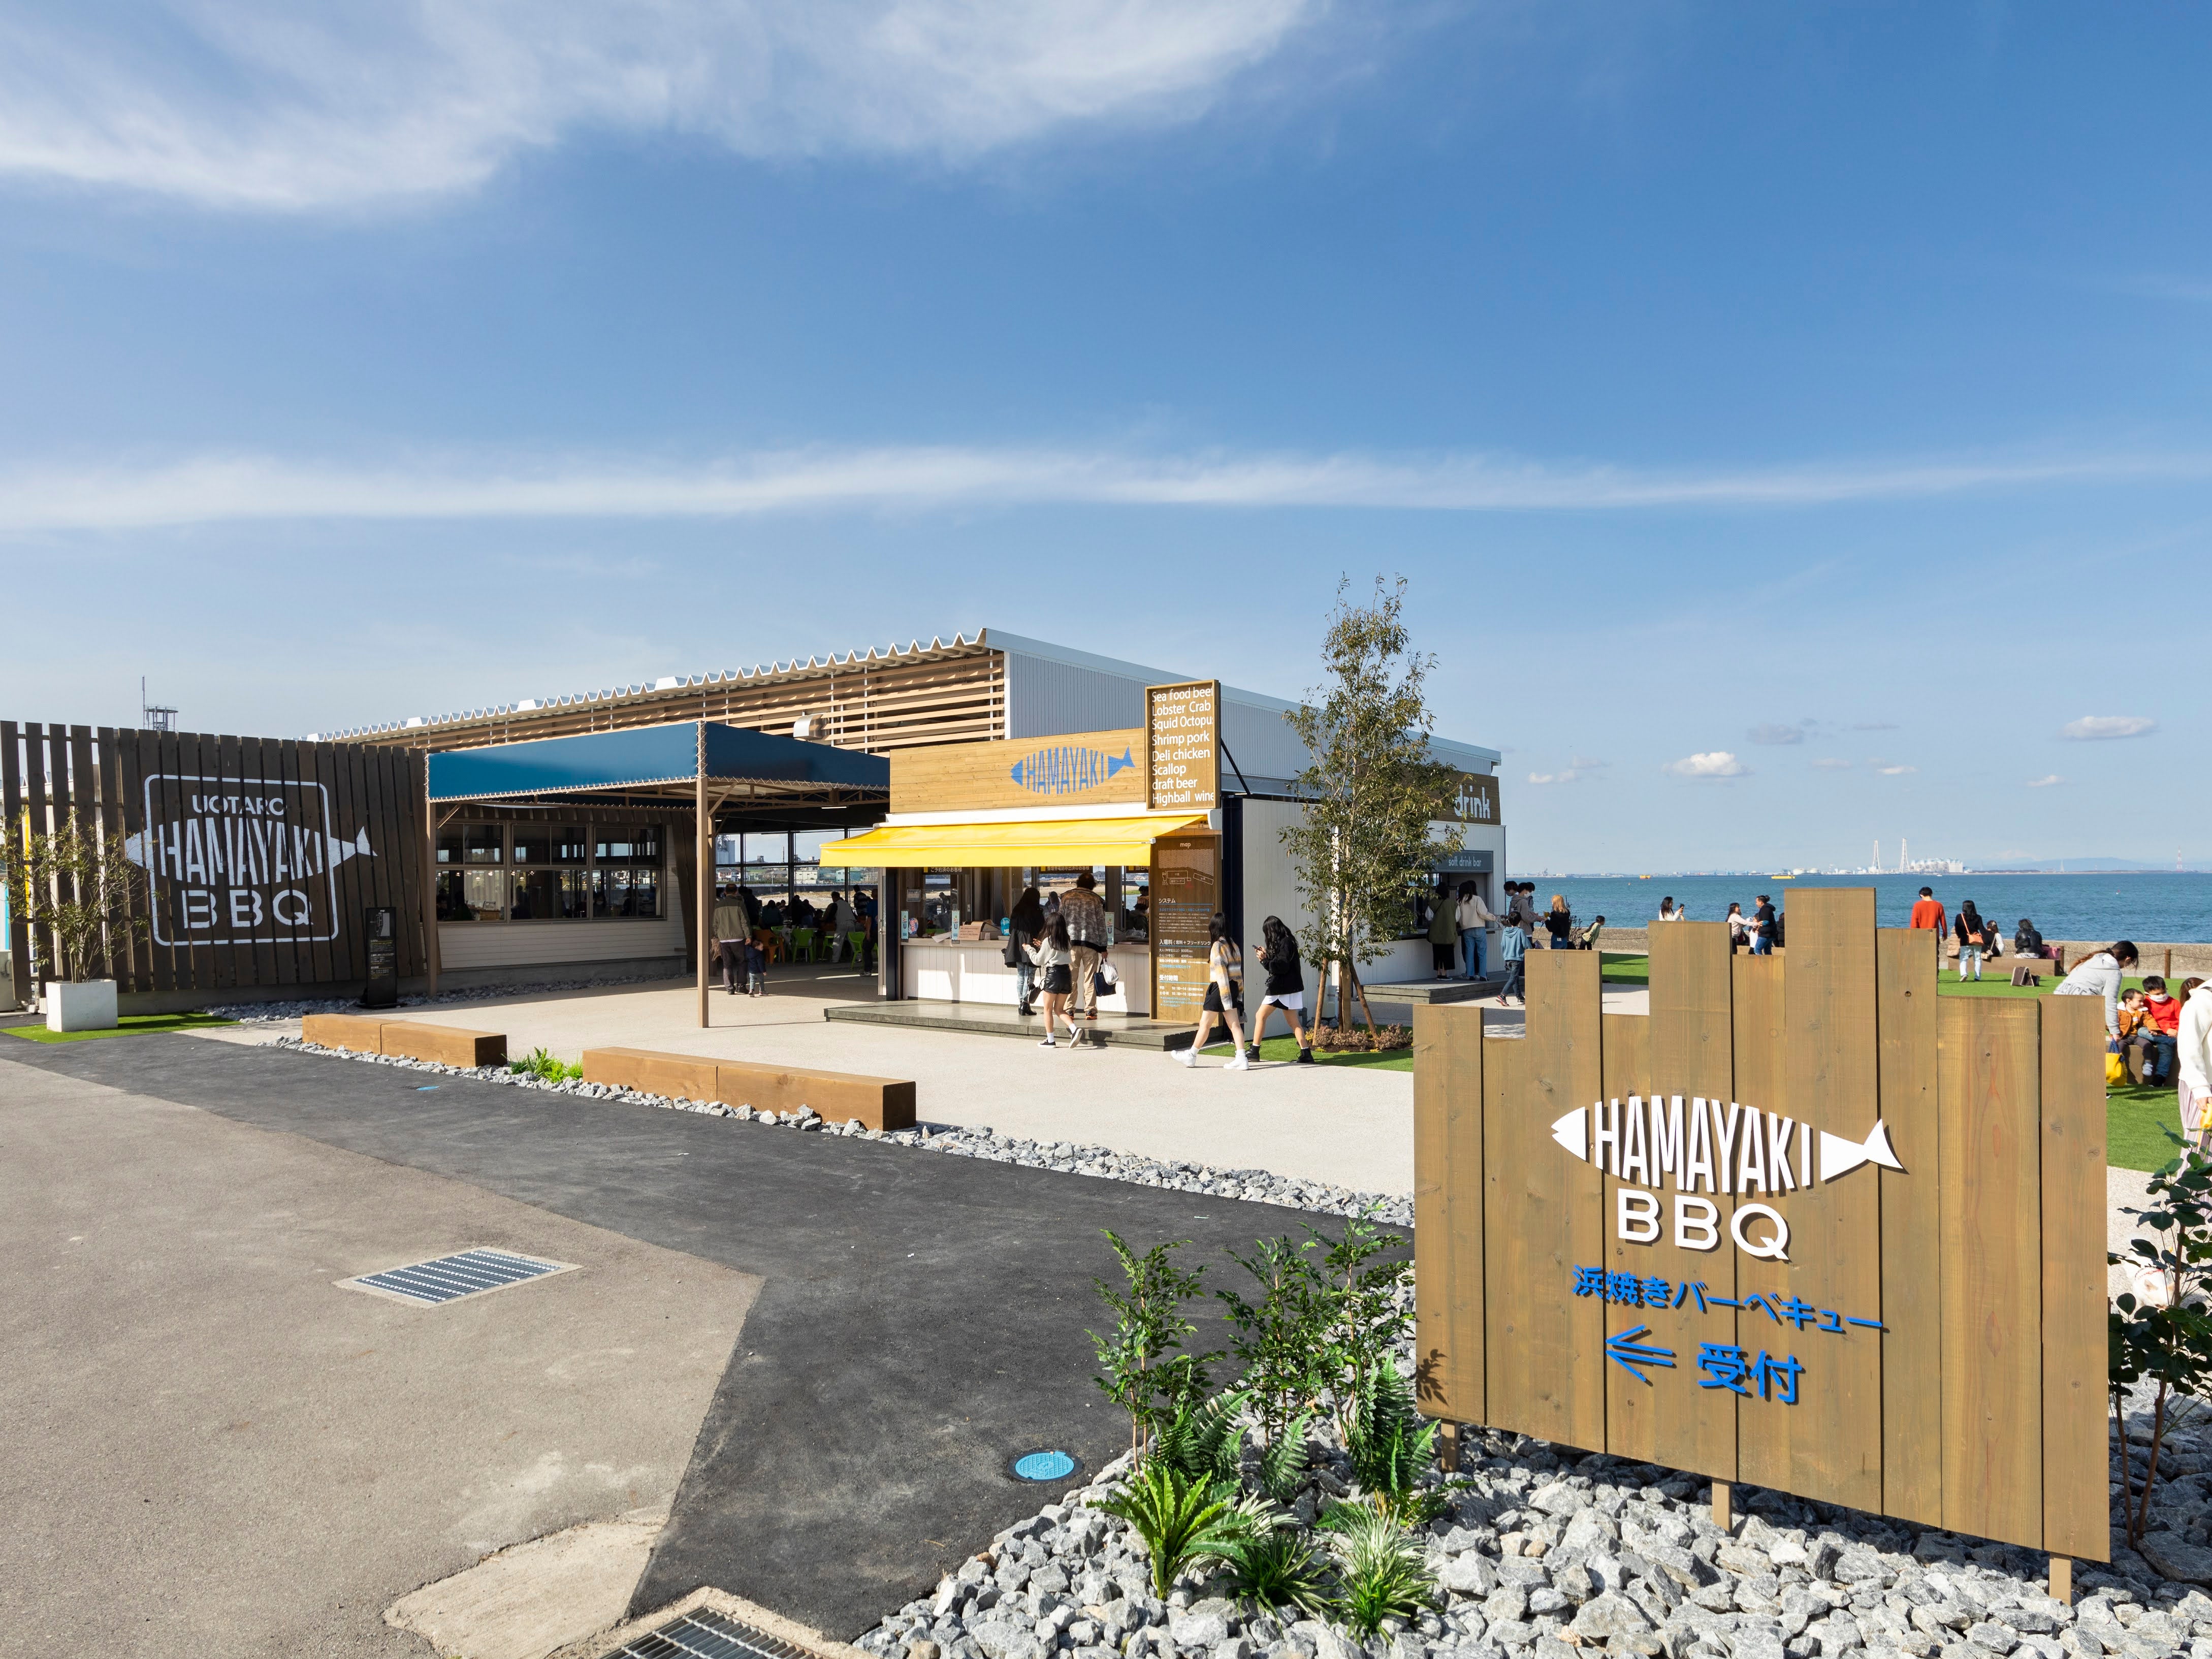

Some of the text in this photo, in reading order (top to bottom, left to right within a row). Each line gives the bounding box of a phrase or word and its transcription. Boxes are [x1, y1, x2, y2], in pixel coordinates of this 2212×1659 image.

[1152, 691, 1167, 702] Sea
[1170, 687, 1191, 700] food
[1152, 700, 1211, 716] Lobster Crab
[1152, 716, 1177, 731] Squid
[1152, 730, 1210, 748] Shrimp pork
[1152, 747, 1210, 762] Deli chicken
[1027, 747, 1104, 794] HAMAYAKI
[1152, 763, 1187, 777] Scallop
[1152, 777, 1197, 790] draft beer
[1152, 790, 1214, 806] Highball wine
[1454, 785, 1490, 819] drink
[158, 817, 324, 886] HAMAYAKI
[1449, 856, 1482, 867] soft drink bar
[181, 889, 314, 929] BBQ
[1595, 1095, 1813, 1193] HAMAYAKI
[1618, 1188, 1789, 1260] BBQ
[1572, 1264, 1883, 1332] 浜焼きバーベキュー
[1697, 1342, 1803, 1403] 受付
